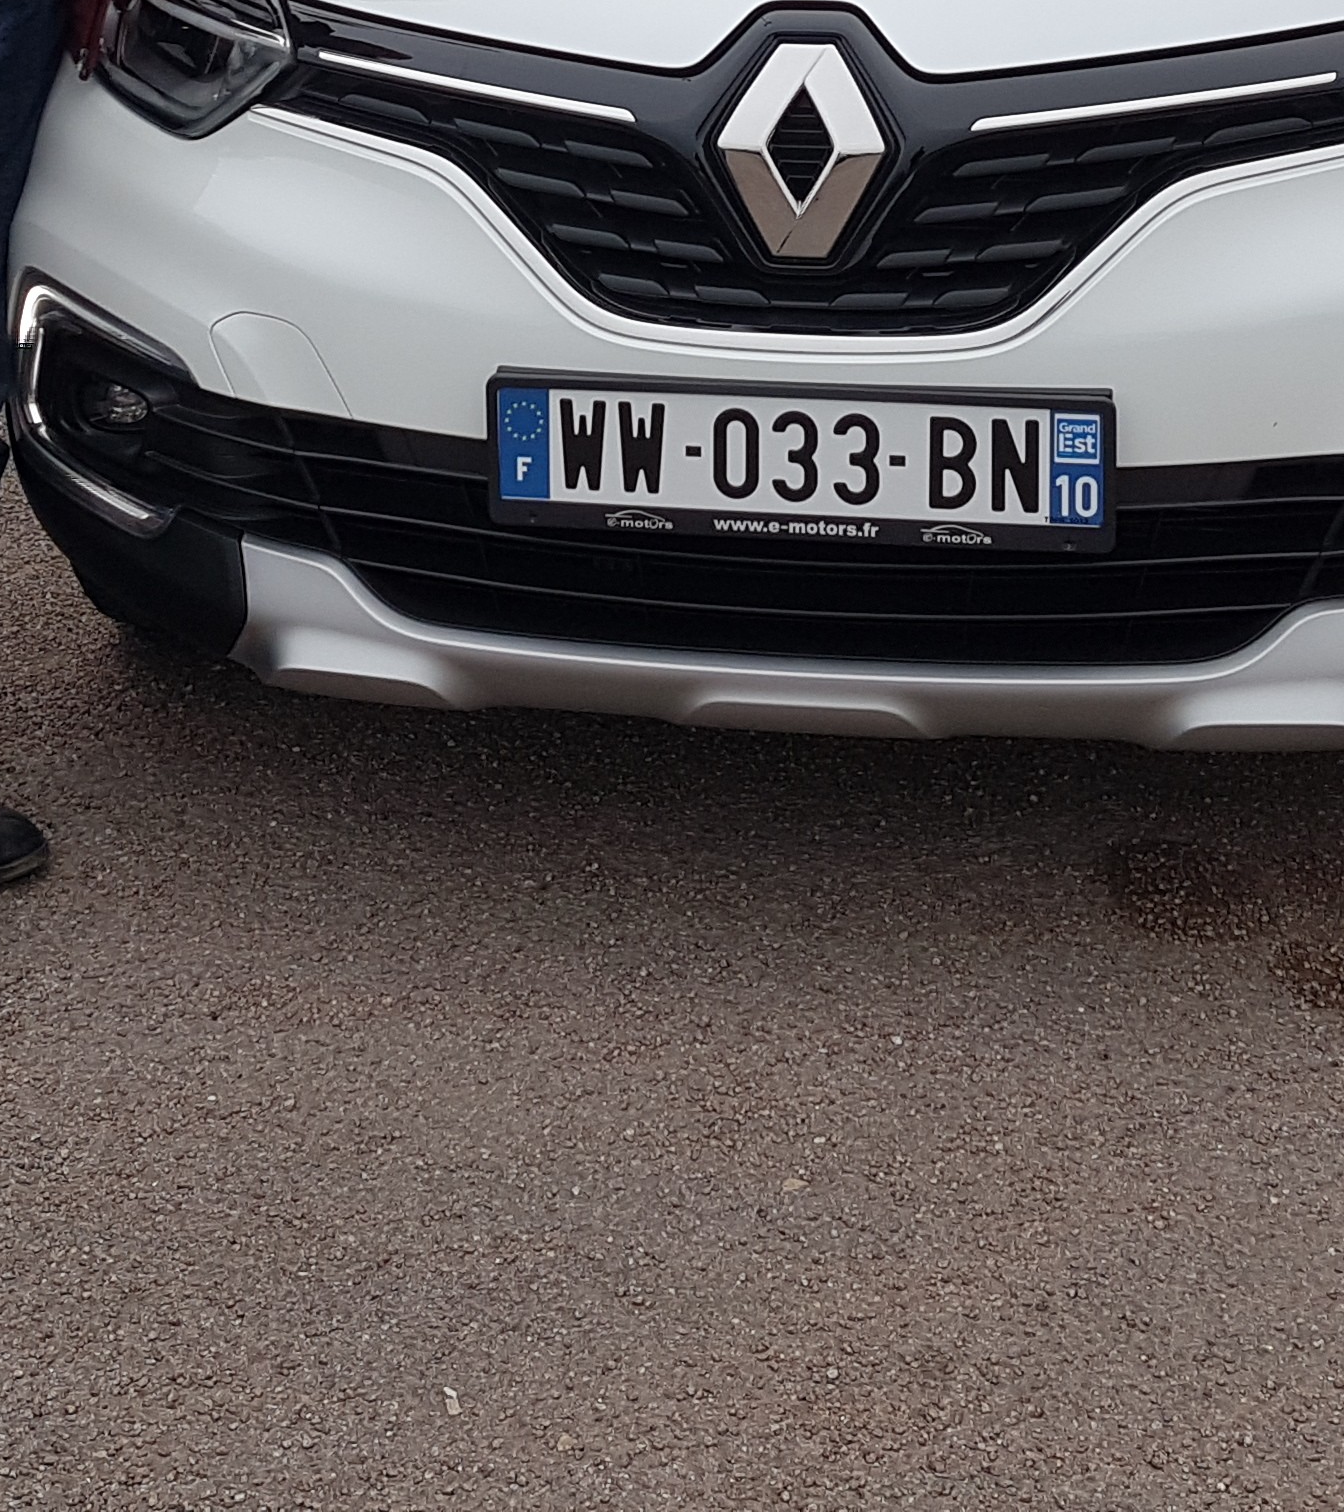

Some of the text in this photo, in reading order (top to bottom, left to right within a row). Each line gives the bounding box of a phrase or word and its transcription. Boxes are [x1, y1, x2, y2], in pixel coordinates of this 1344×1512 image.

[1058, 422, 1096, 433] Grand
[1058, 433, 1096, 454] Est
[517, 456, 532, 481] F
[1055, 474, 1098, 518] 10
[713, 518, 880, 538] www.e-motors.fr
